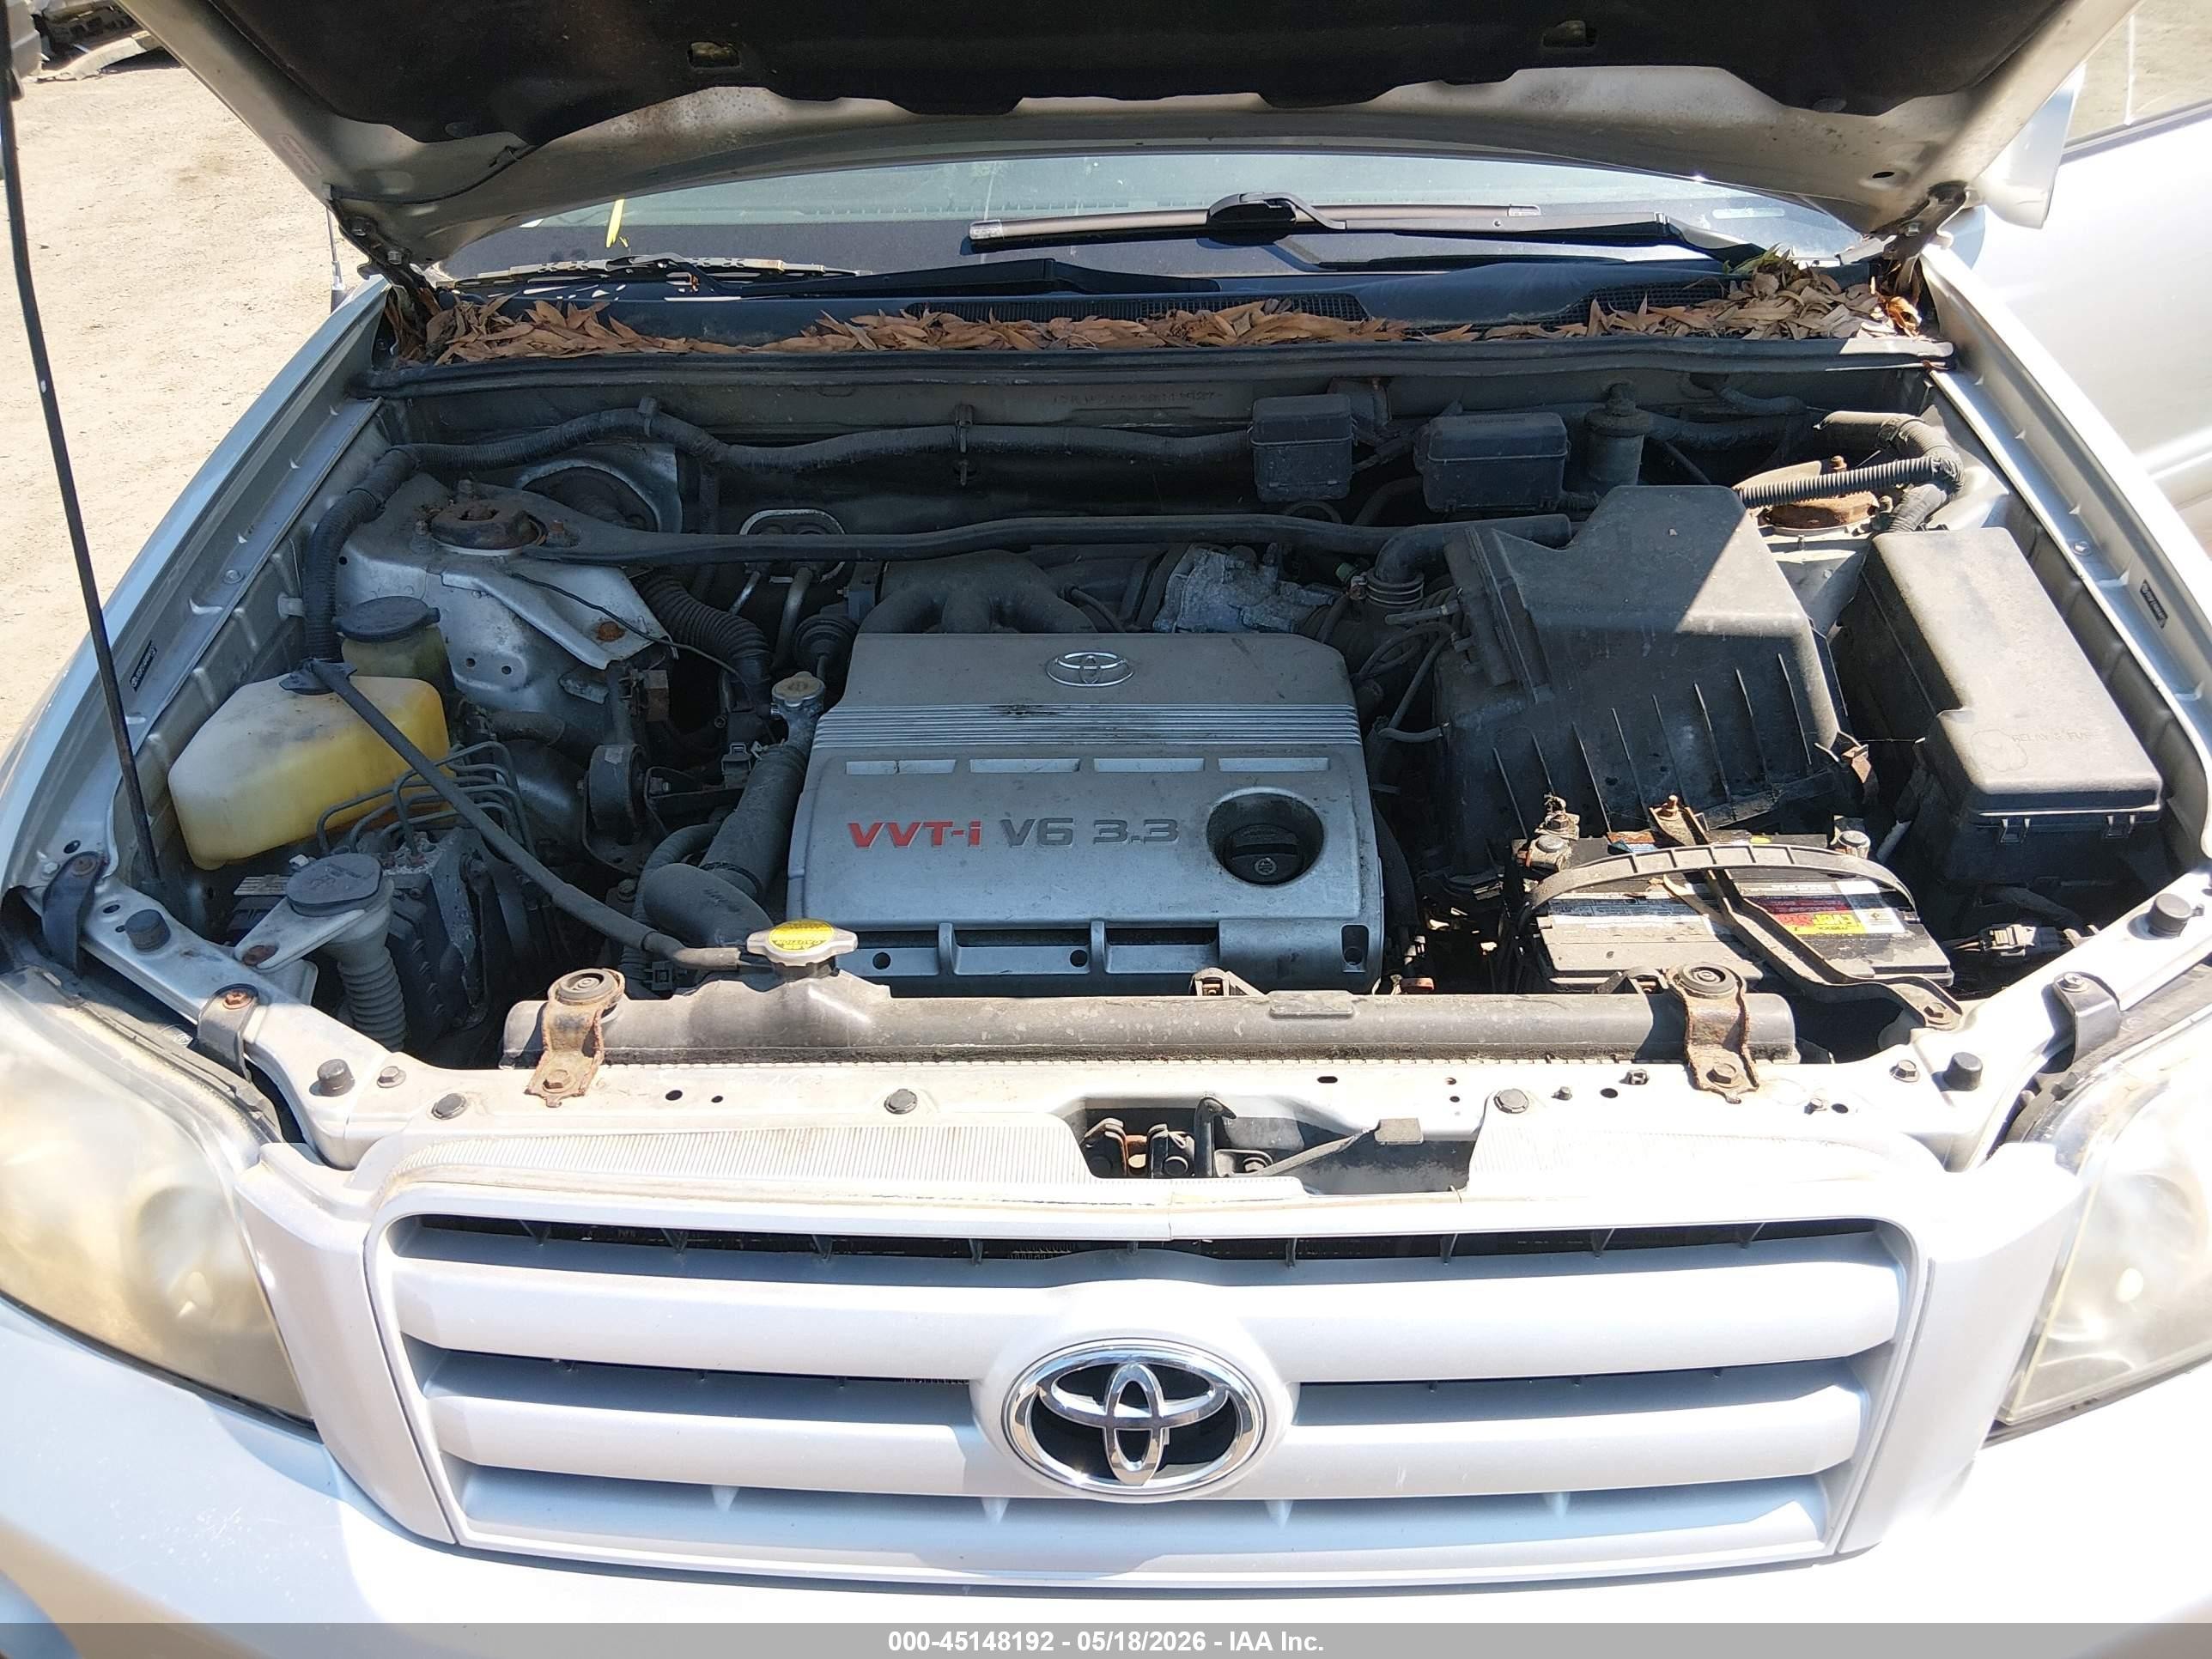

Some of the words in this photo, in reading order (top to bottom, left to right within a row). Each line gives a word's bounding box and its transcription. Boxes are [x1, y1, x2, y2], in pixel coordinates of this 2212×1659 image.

[848, 820, 981, 848] VVT-i
[1001, 817, 1074, 848] V6
[1093, 818, 1179, 845] 3.3
